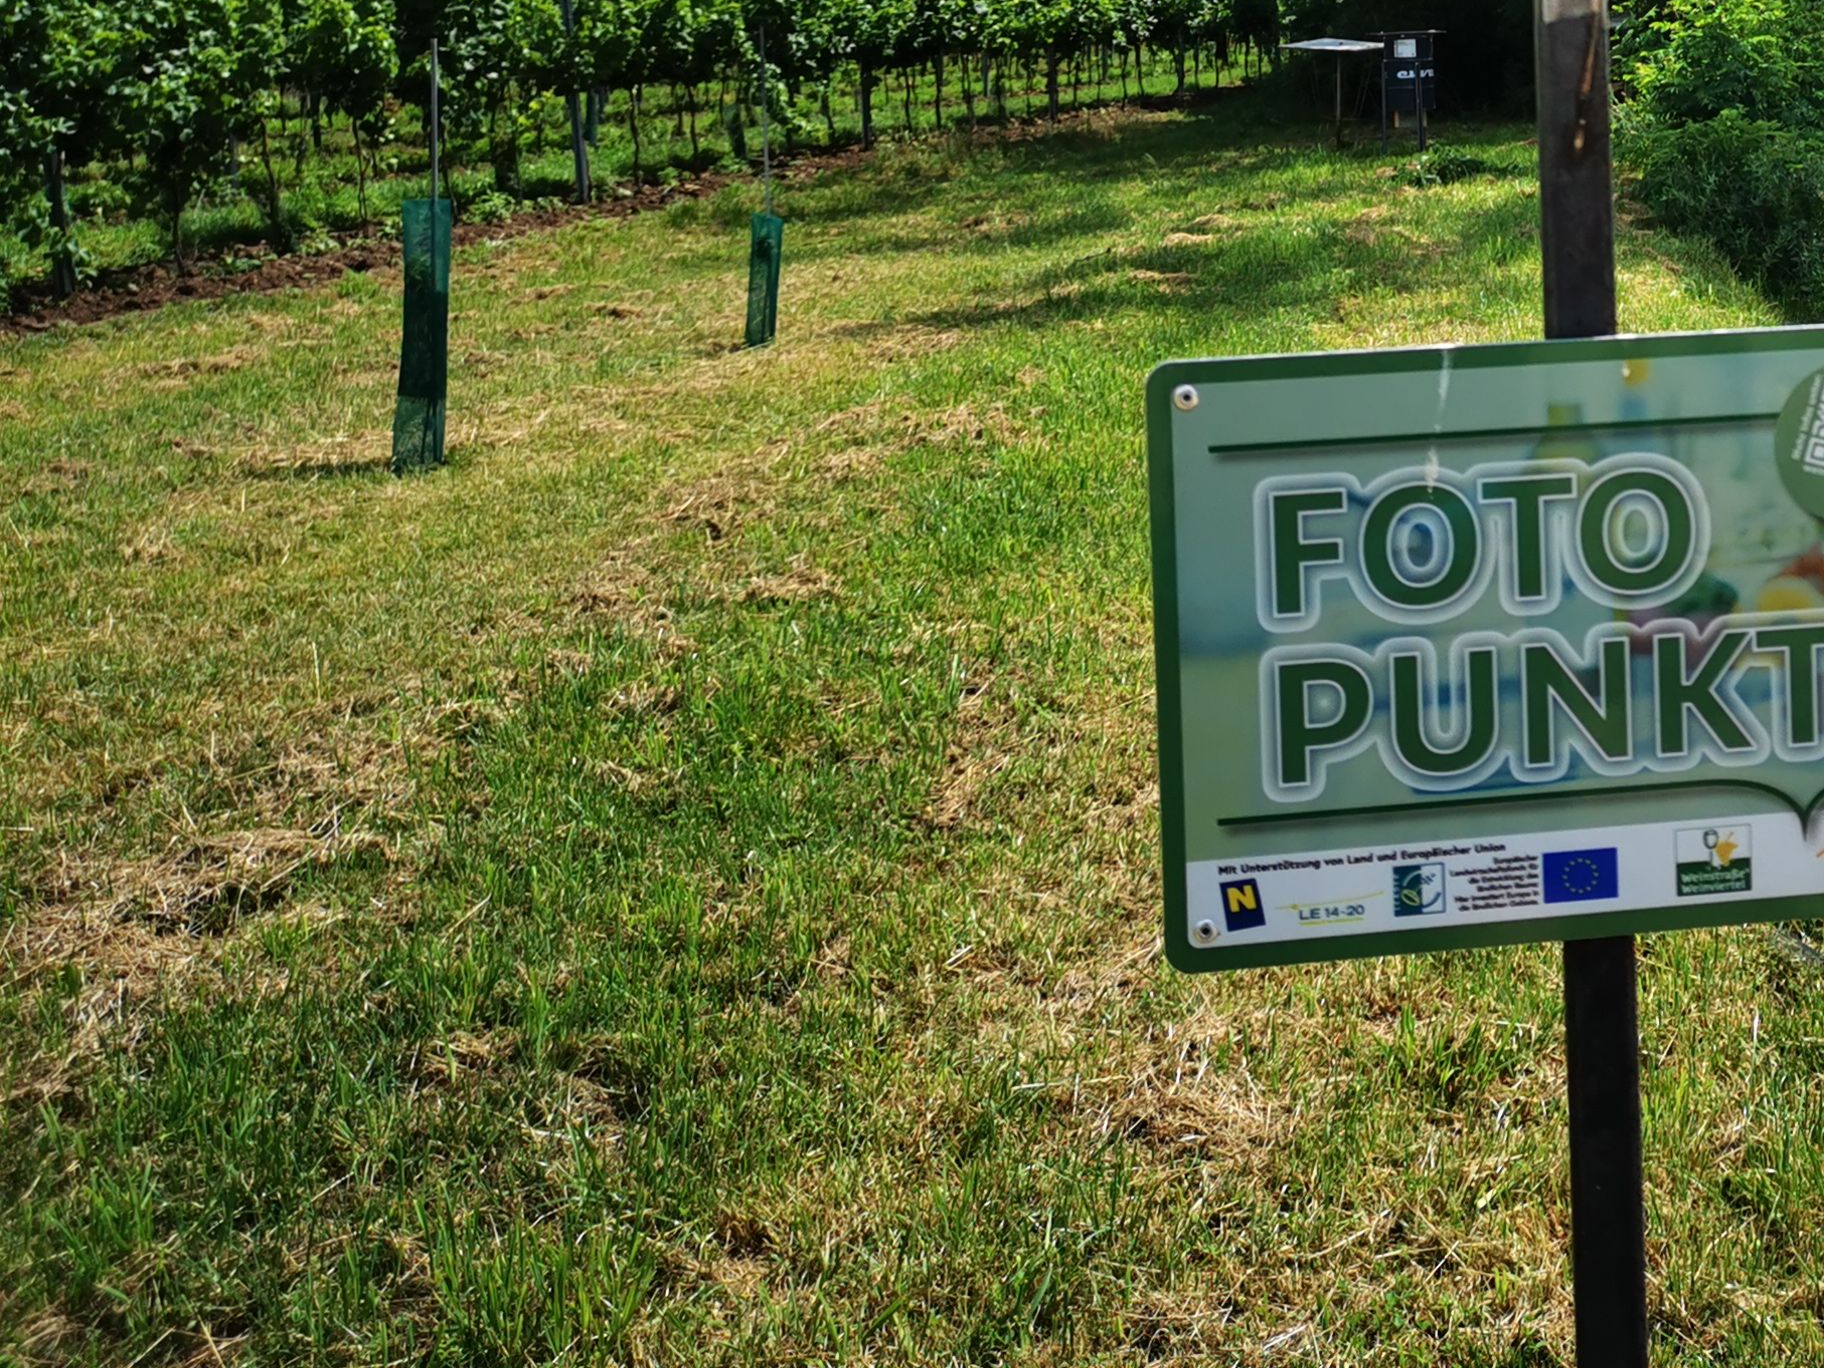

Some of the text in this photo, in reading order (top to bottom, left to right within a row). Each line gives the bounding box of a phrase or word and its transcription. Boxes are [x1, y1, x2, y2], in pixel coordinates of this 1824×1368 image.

[1267, 465, 1698, 622] FOTO
[1218, 843, 1506, 876] Mit Unterstützung von Land und Europäischer Union
[1226, 884, 1257, 913] N
[1299, 904, 1366, 920] LE 14-20
